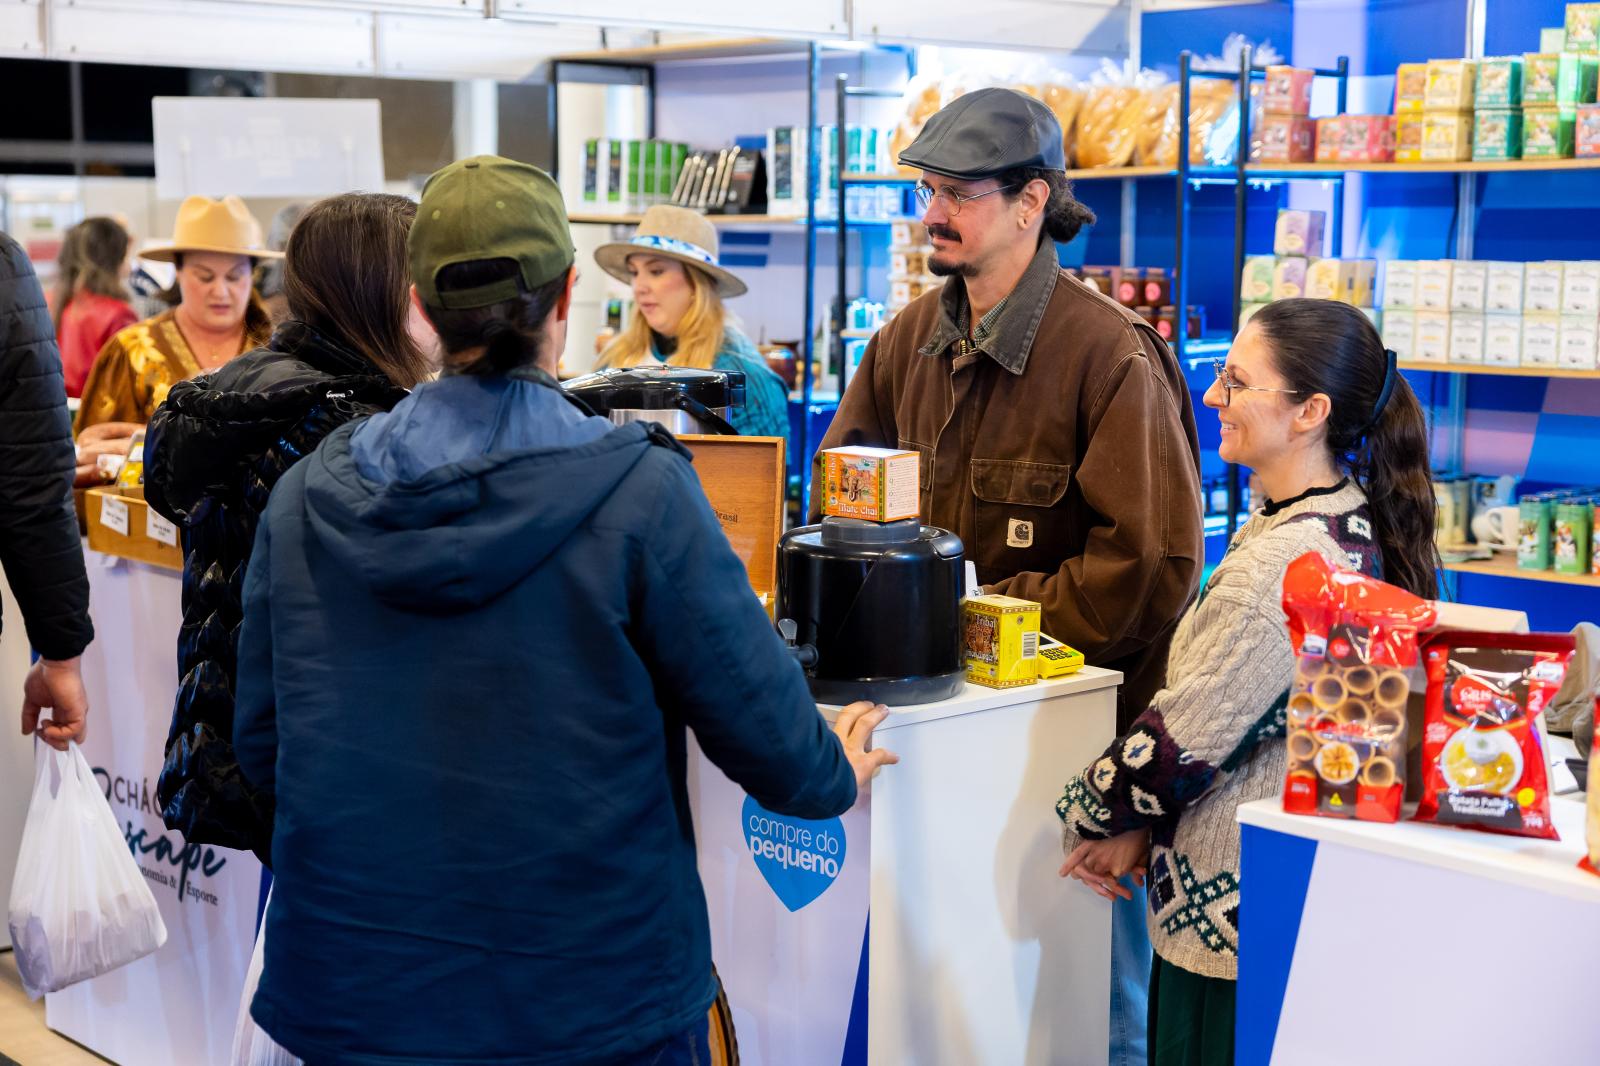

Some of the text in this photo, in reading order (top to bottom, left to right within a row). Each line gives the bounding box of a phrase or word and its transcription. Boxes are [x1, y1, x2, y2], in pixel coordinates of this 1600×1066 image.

[749, 815, 839, 855] compre do
[749, 834, 839, 878] pequeno
[186, 880, 219, 907] Esporte
